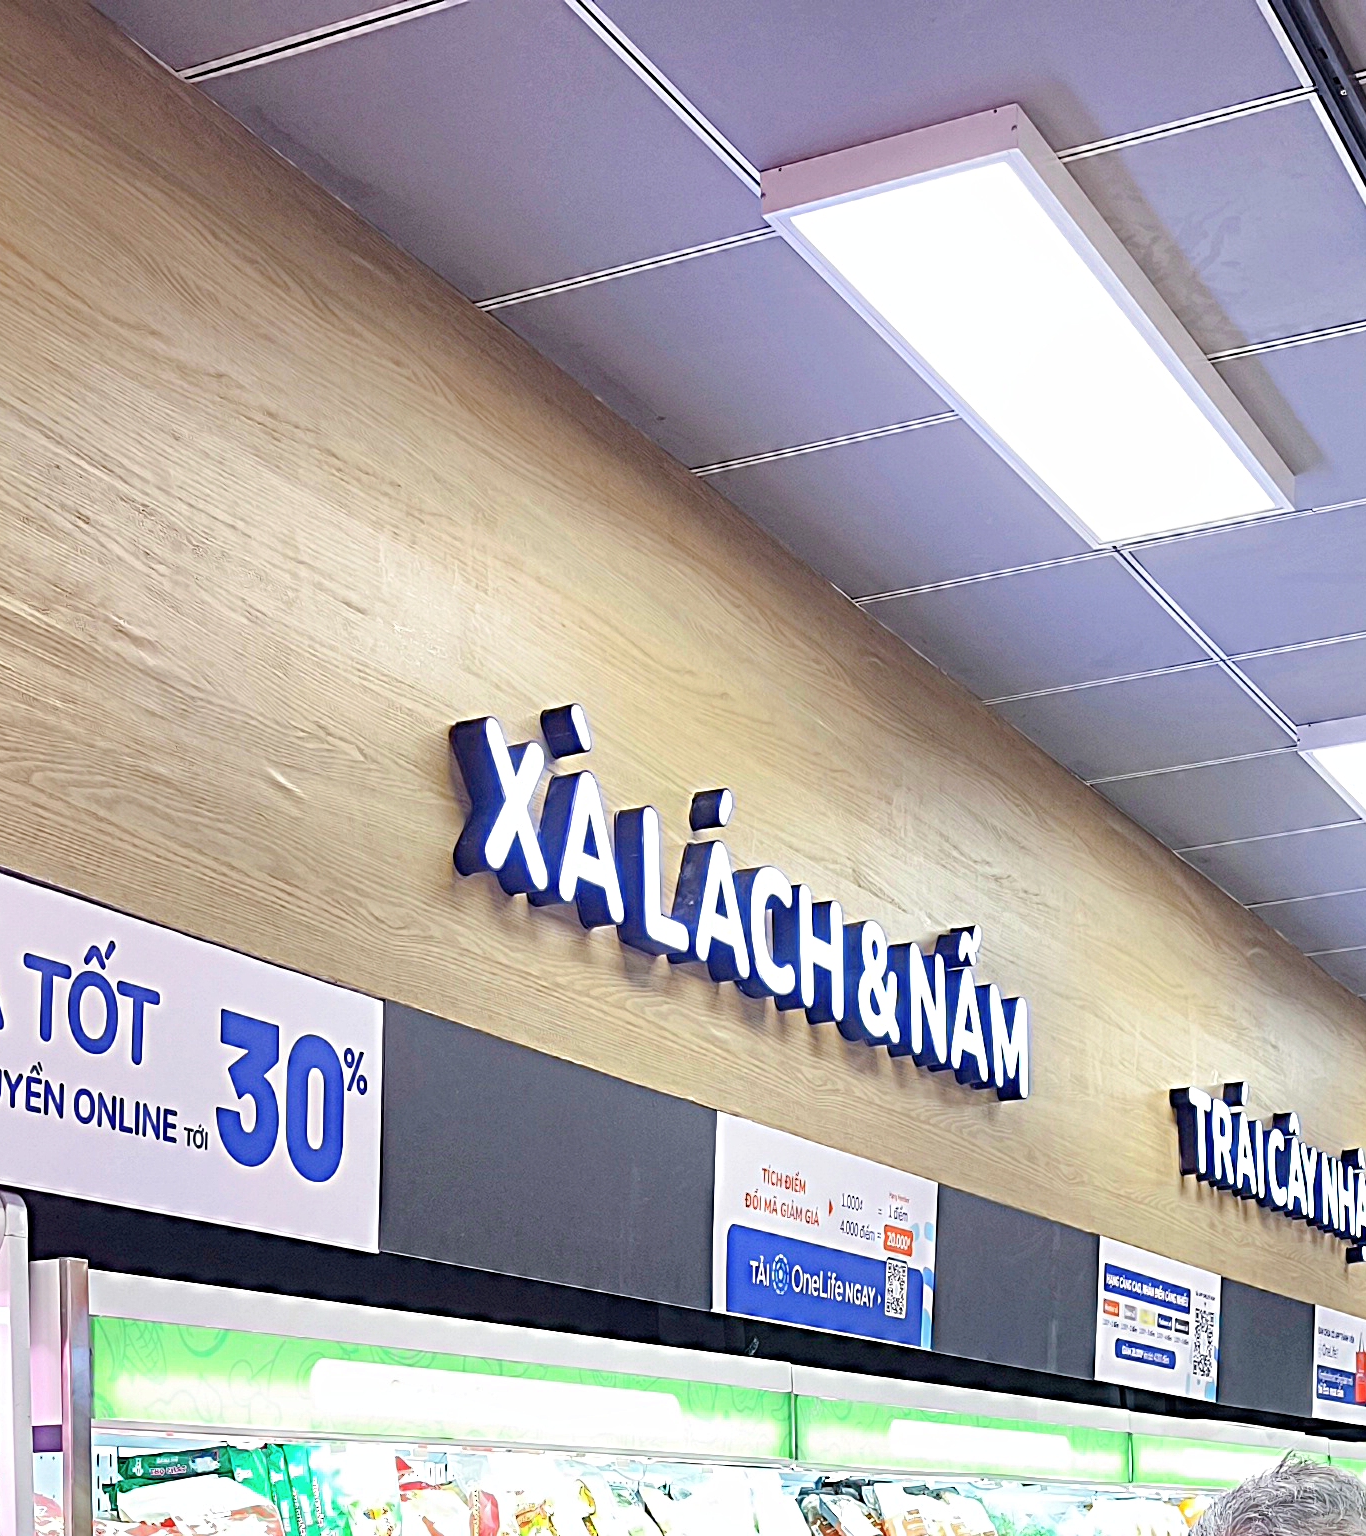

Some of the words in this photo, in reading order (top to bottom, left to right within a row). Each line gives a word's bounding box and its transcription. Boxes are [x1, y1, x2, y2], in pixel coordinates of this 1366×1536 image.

[615, 788, 844, 1022] LÁCH
[839, 920, 900, 1046] &
[888, 925, 1030, 1101] NẤM
[22, 940, 161, 1066] TỐT
[72, 1088, 178, 1144] ONLINE
[1169, 1081, 1265, 1199] TRÁI
[1257, 1112, 1318, 1219] CÂY
[744, 1188, 762, 1210] ĐỔI
[764, 1196, 778, 1215] MÃ
[780, 1201, 803, 1223] GIẢM
[804, 1206, 820, 1227] GIÁ
[762, 1164, 783, 1189] TÍCH
[784, 1171, 806, 1195] ĐIỂM
[749, 1254, 770, 1288] TẢI
[791, 1264, 844, 1302] OneLife
[845, 1285, 876, 1309] NGAY
